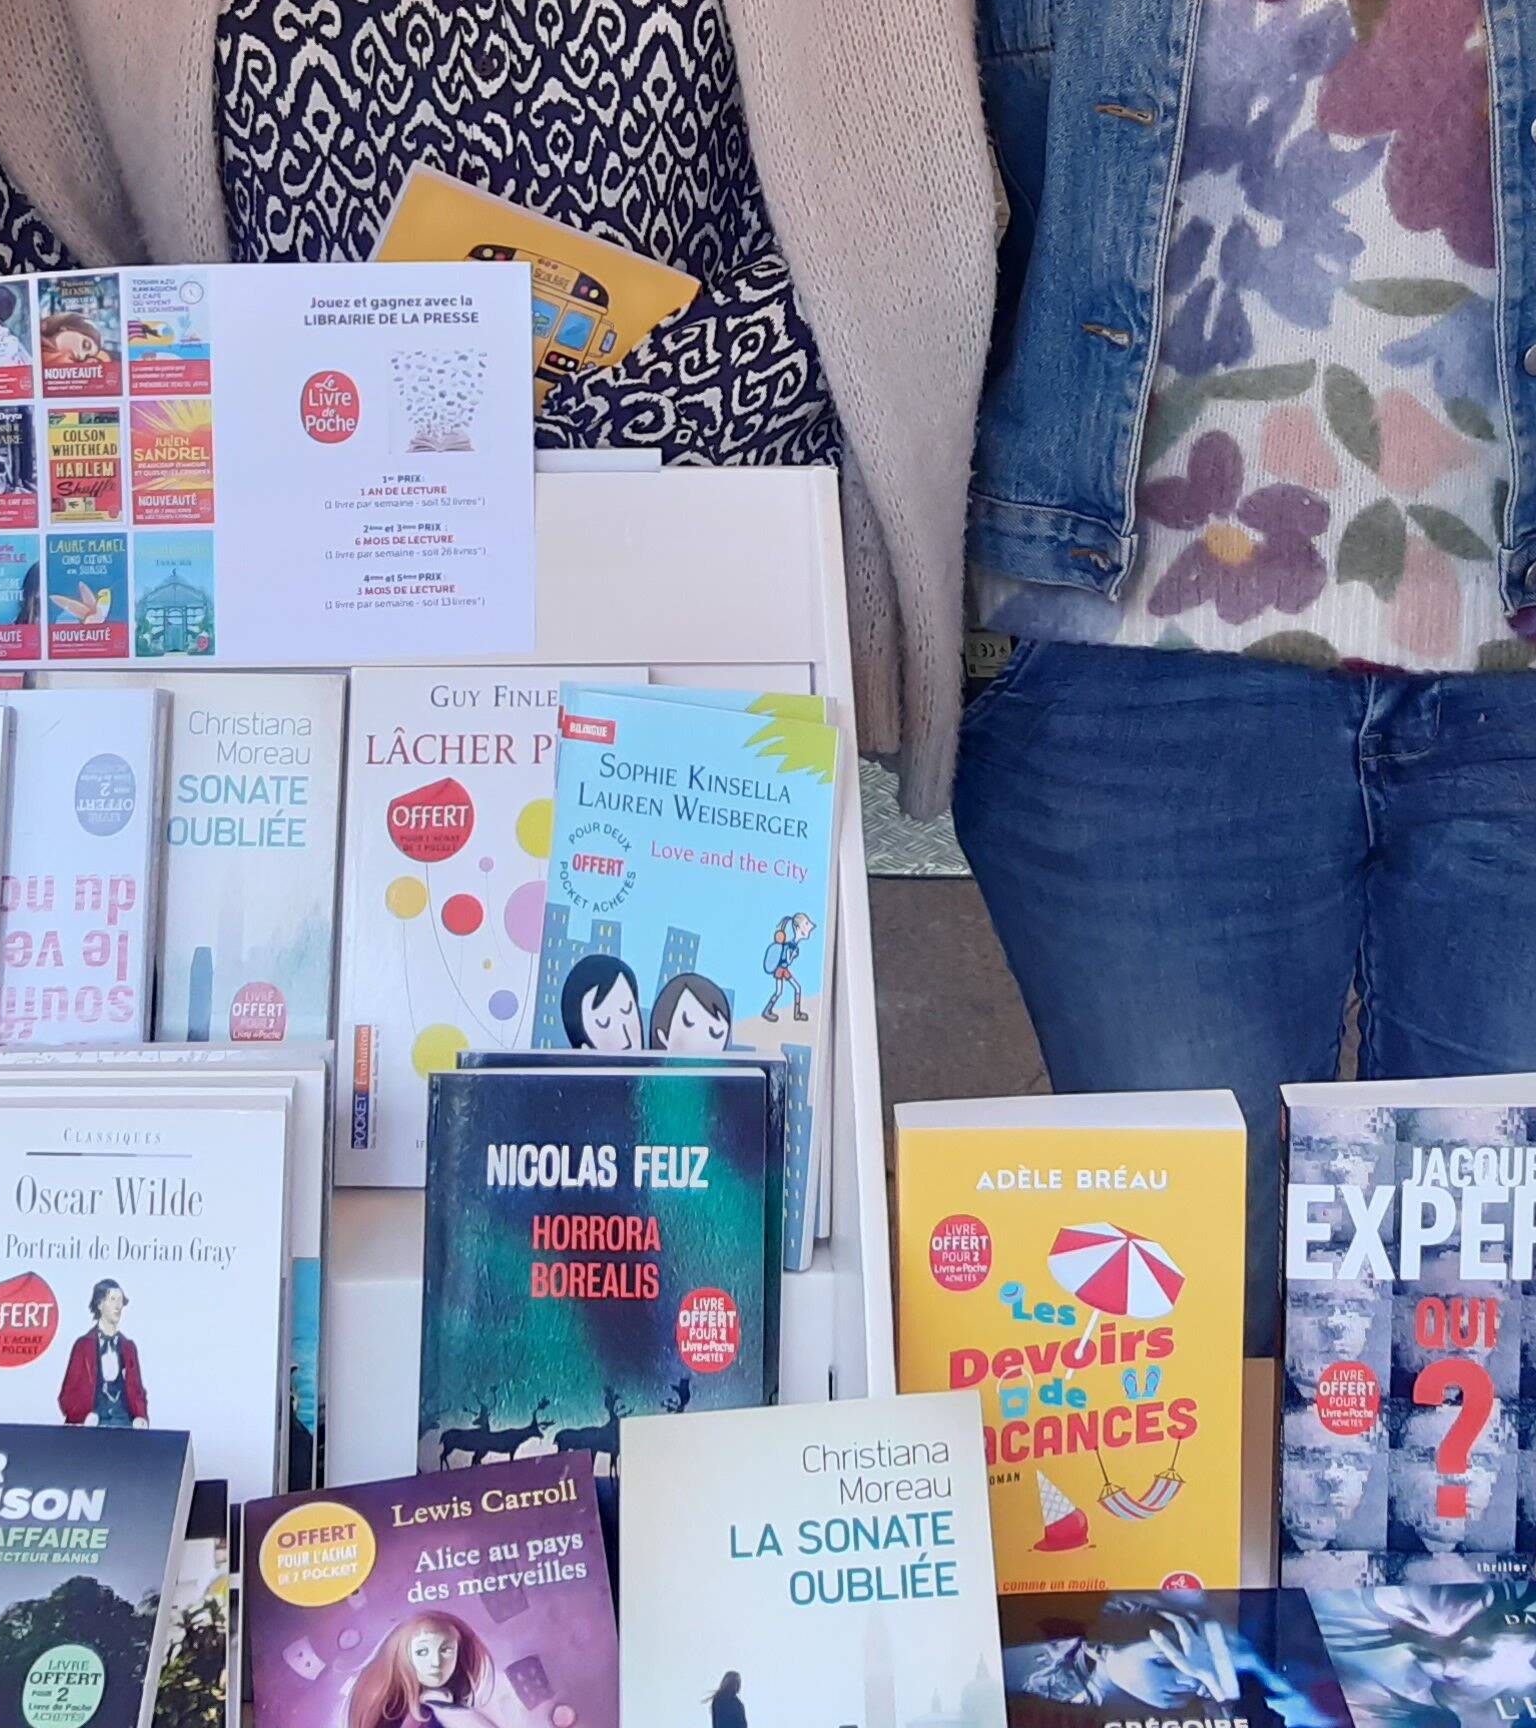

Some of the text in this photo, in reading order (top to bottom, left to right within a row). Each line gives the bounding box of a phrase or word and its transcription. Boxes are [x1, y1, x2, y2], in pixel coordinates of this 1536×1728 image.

[305, 312, 479, 326] LIBRAIRIE DE LA PRESSE
[310, 294, 473, 311] Jouez et gagnez avec la
[52, 443, 117, 457] WHITEHEAD
[63, 429, 106, 442] COLSON
[56, 461, 115, 478] HARLEM
[134, 447, 209, 461] SANDREL
[367, 727, 513, 765] LÂCHER
[600, 753, 790, 805] SOPHIE KINSELLA
[579, 782, 808, 840] LAUREN WEISBERGER
[572, 853, 623, 876] OFFERT
[487, 1145, 709, 1189] NICOLAS FEUZ
[976, 1163, 1168, 1192] ADÈLE BRÉAU
[15, 1174, 204, 1217] Oscar Wilde
[532, 1215, 660, 1251] HORRORA
[531, 1262, 660, 1299] BOREALIS
[1414, 1297, 1498, 1348] QUI
[802, 1440, 950, 1473] Christiana
[391, 1480, 579, 1529] Lewis Carroll
[840, 1476, 952, 1505] Moreau
[797, 1510, 955, 1553] SONATE
[789, 1553, 959, 1606] OUBLIÉE
[1475, 1560, 1528, 1574] thriller
